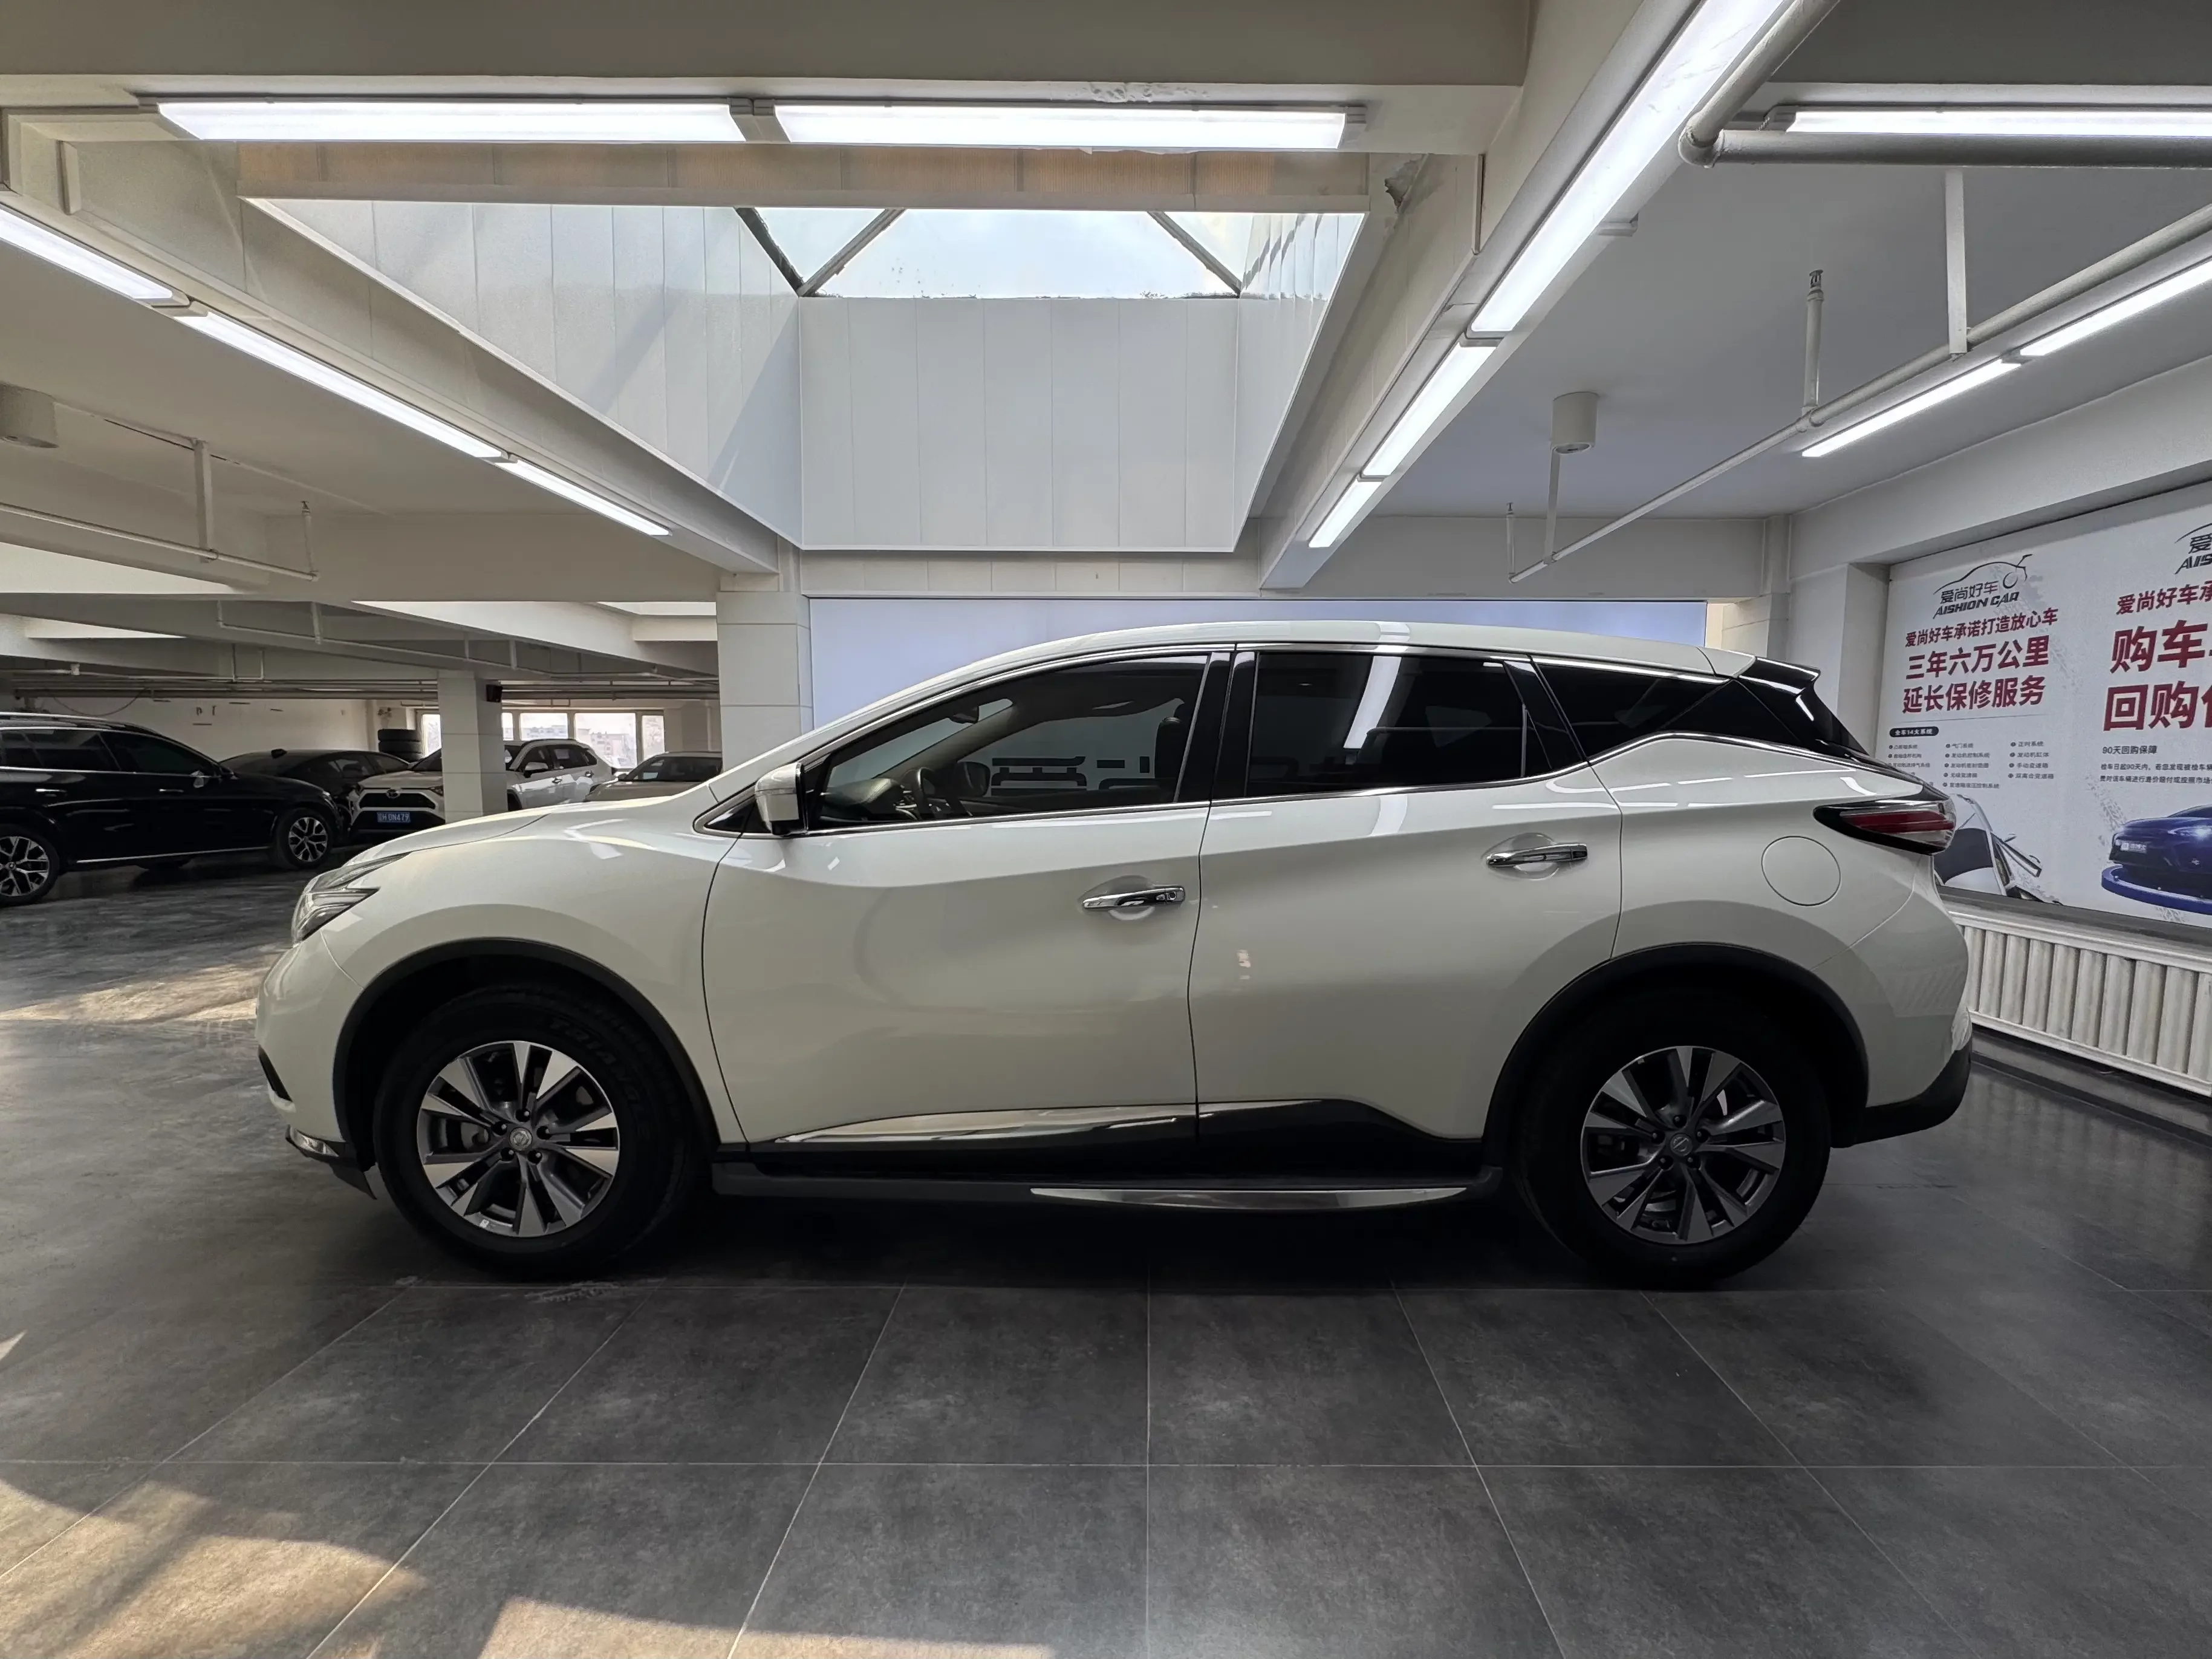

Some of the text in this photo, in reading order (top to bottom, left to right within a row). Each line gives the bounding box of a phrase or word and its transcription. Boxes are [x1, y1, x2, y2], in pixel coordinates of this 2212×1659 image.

[1933, 591, 2020, 619] AISHION CAR
[1940, 581, 1999, 604] 爱尚好车
[1905, 607, 2059, 647] 爱尚好车承诺打造放心车
[2110, 620, 2212, 673] 购车
[1905, 634, 2050, 680] 三年六万公里
[1902, 674, 2046, 714] 延长保修服务
[2103, 680, 2212, 731] 回购
[2102, 745, 2157, 754] 90天回购保障
